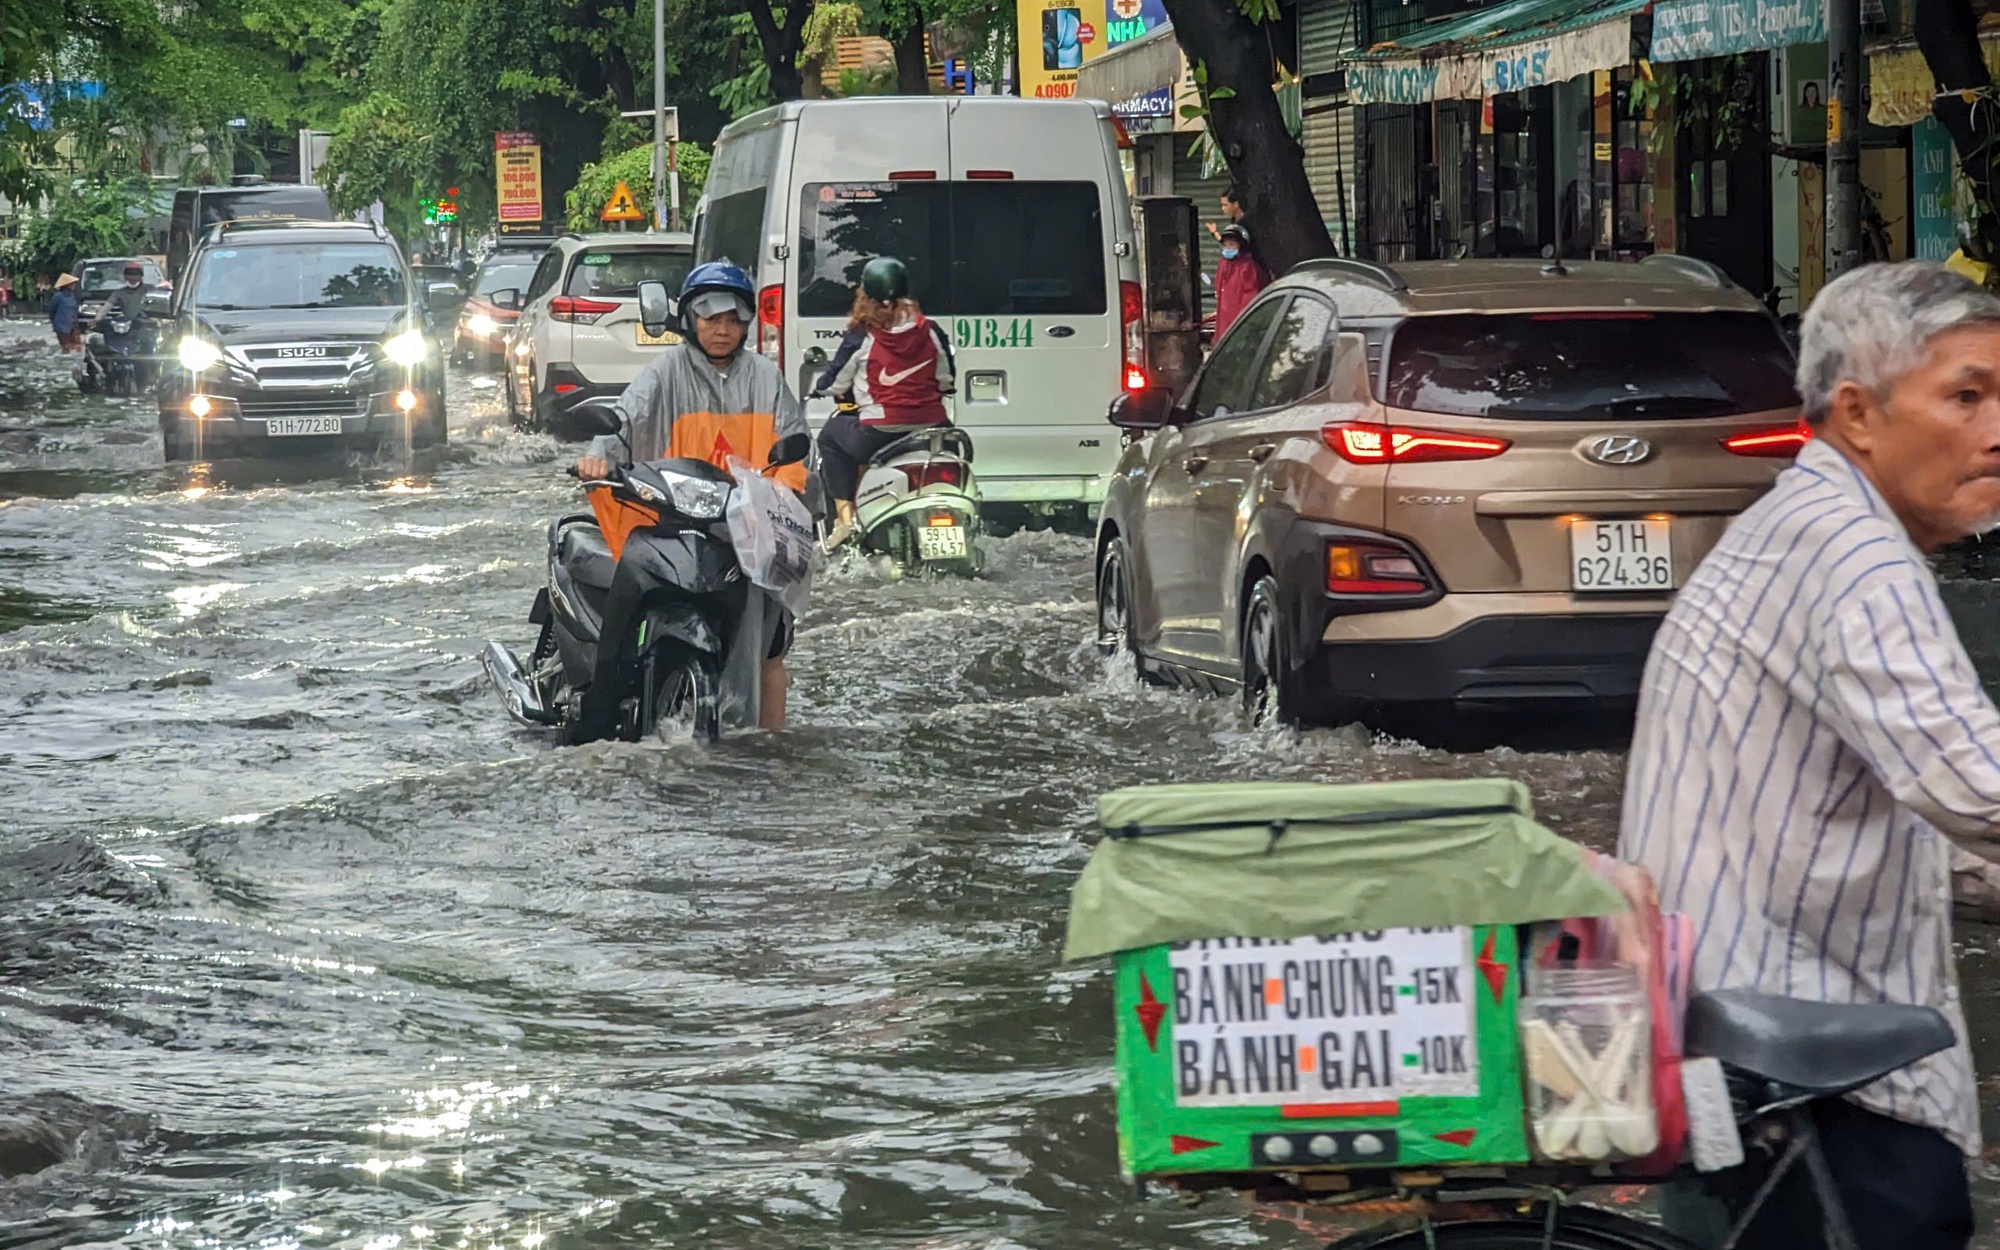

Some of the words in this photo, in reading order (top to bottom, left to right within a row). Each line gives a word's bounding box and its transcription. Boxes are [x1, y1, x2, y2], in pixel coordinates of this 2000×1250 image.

[1107, 16, 1147, 42] NHÀ
[503, 173, 536, 183] 100.000
[504, 189, 536, 199] 700.000
[585, 254, 611, 265] Grab
[957, 318, 1033, 348] 913.44
[278, 348, 326, 358] ISUZU
[269, 418, 339, 434] 51H-772.80
[926, 528, 958, 541] 59-L1
[1596, 524, 1647, 553] 51H
[923, 542, 964, 557] 664.57
[1577, 557, 1669, 586] 624.36
[1172, 953, 1268, 1025] BÁNH
[1411, 966, 1462, 1005] 15K
[1177, 1024, 1299, 1097] BÁNH
[1319, 1029, 1393, 1091] GAI
[1417, 1034, 1468, 1075] 10K
